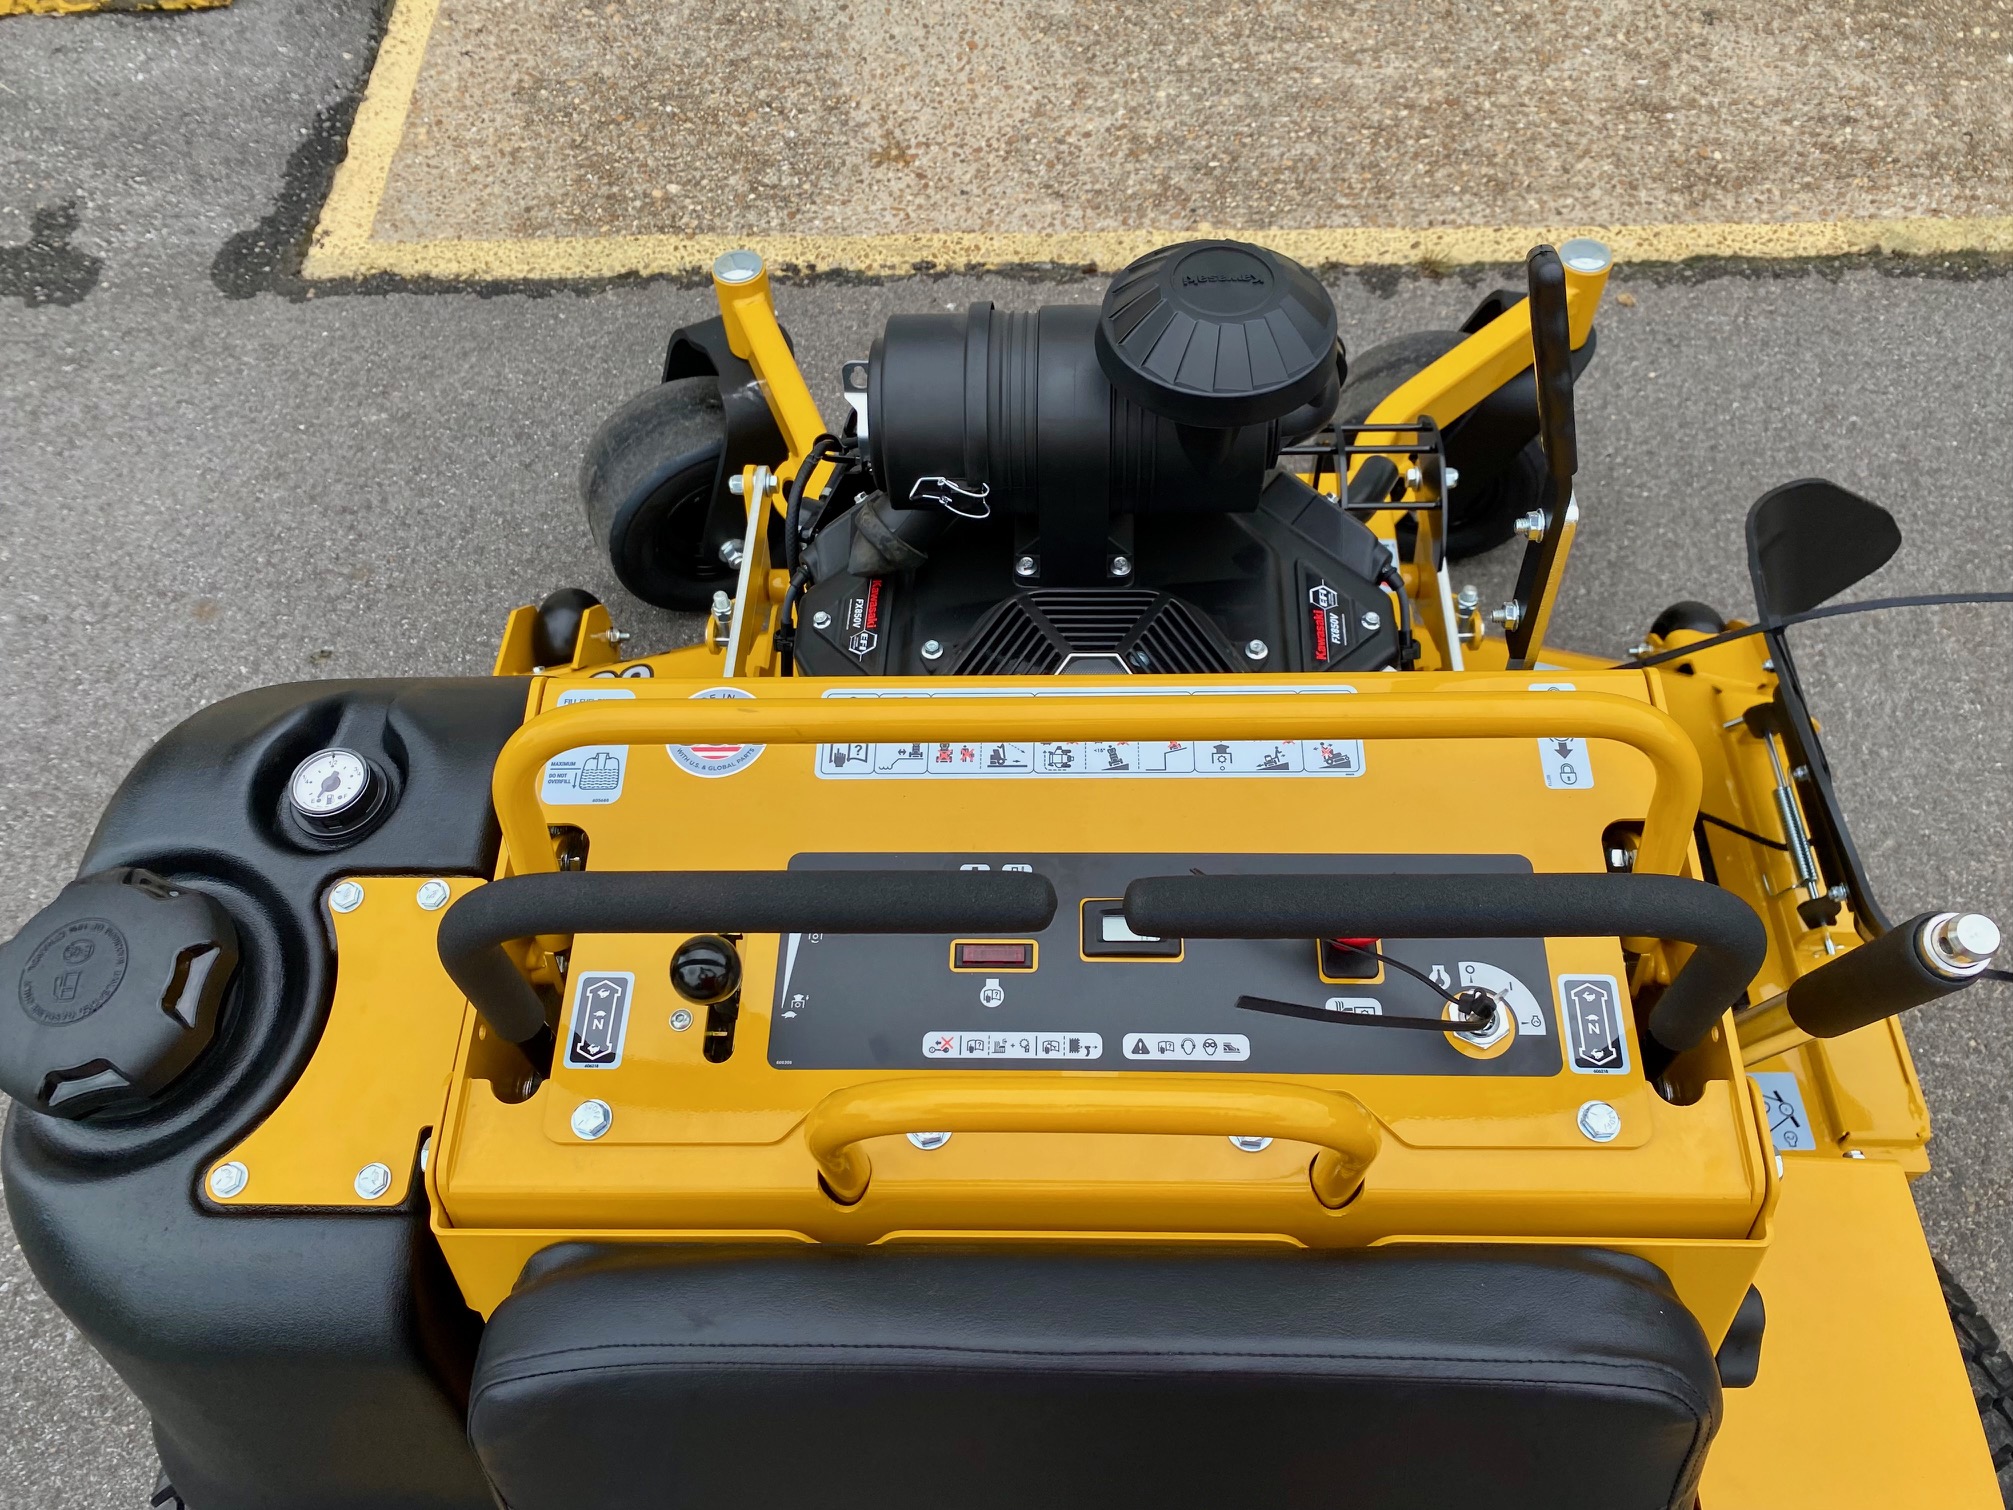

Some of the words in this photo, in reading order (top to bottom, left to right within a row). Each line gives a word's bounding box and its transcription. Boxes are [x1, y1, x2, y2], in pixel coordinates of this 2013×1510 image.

[867, 580, 882, 628] Kawasaki
[1319, 589, 1328, 607] EFI
[853, 599, 864, 628] FX850V
[1313, 610, 1327, 660] Kawasaki
[1330, 612, 1341, 644] FX850V
[859, 632, 868, 650] EFI
[677, 747, 690, 763] WITH
[689, 760, 700, 768] U.S.
[708, 762, 736, 771] GLOBAL
[736, 748, 755, 764] PARTS
[592, 1018, 604, 1030] N
[1588, 1022, 1600, 1035] N
